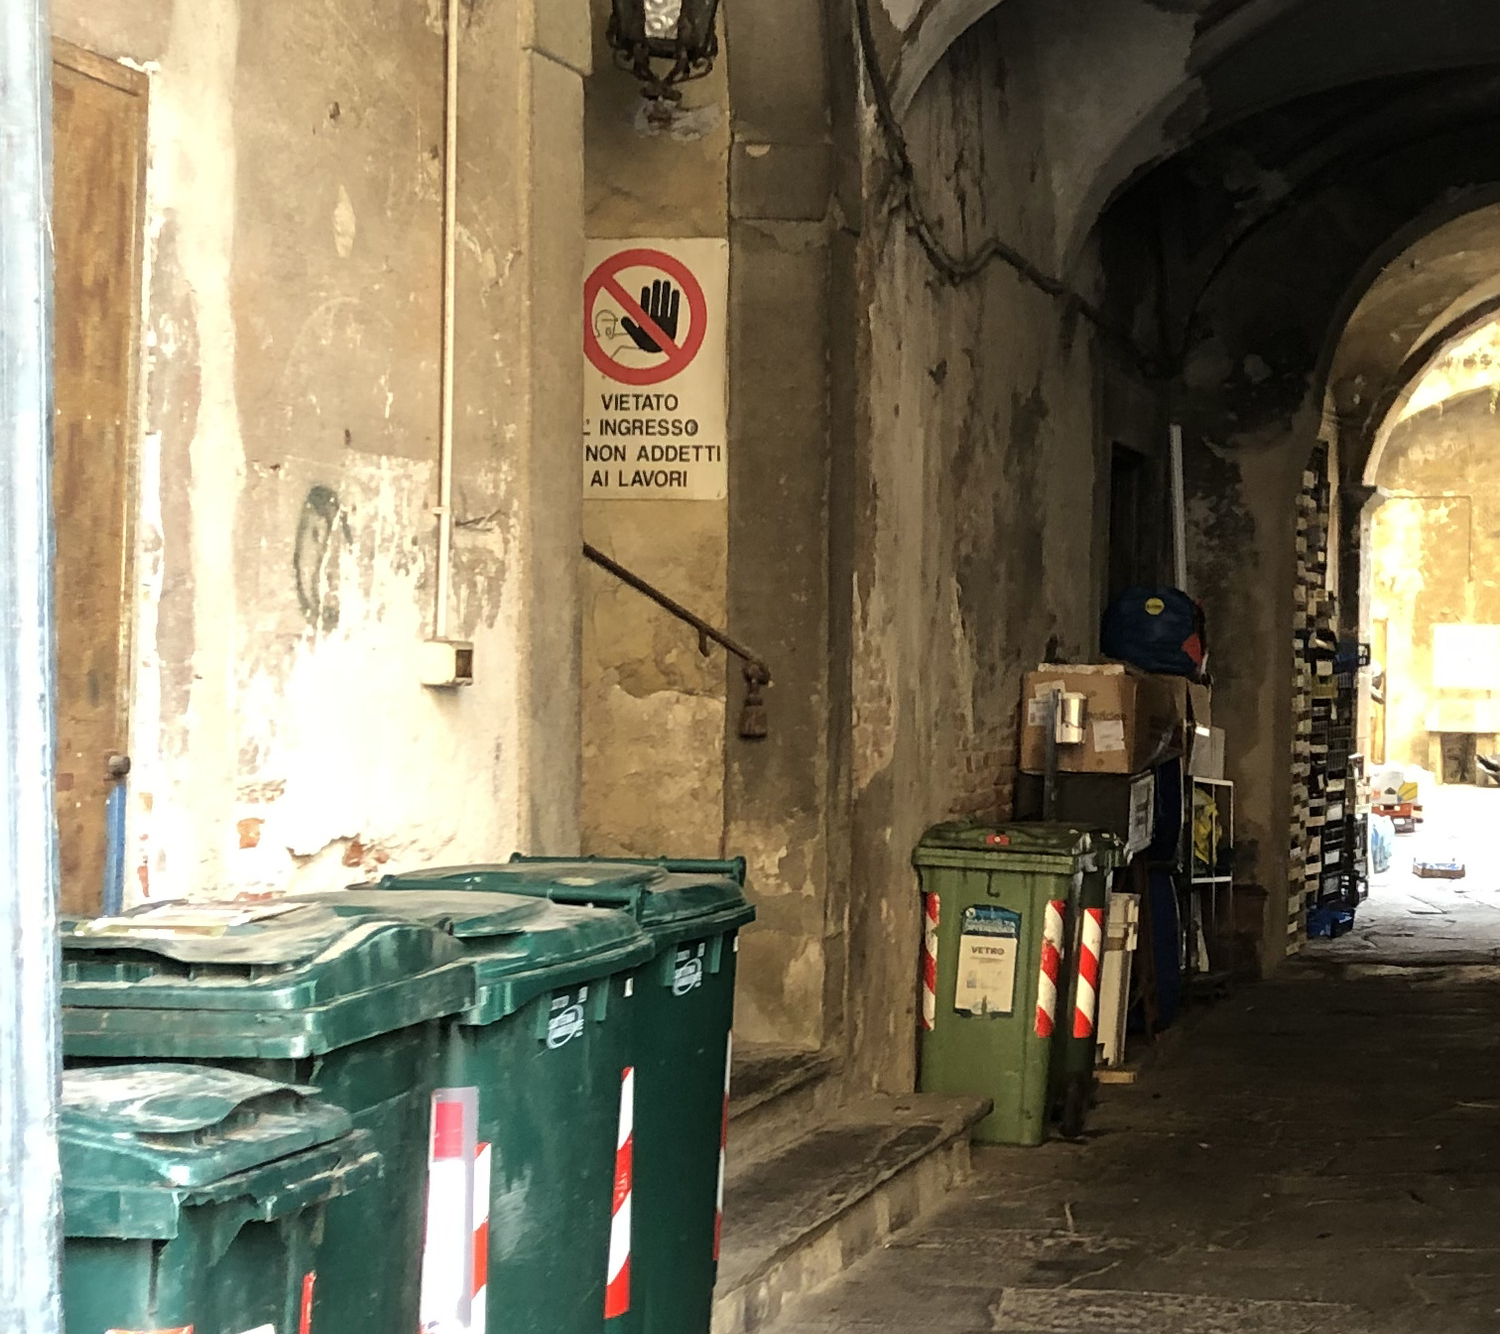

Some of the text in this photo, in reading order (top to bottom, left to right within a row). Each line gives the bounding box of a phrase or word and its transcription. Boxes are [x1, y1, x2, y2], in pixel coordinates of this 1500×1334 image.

[601, 393, 679, 411] VIETATO
[599, 419, 699, 436] INGRESSO
[585, 445, 721, 462] NON ADDETTI
[590, 470, 688, 487] AI LAVORI
[971, 946, 1005, 956] VETRO
